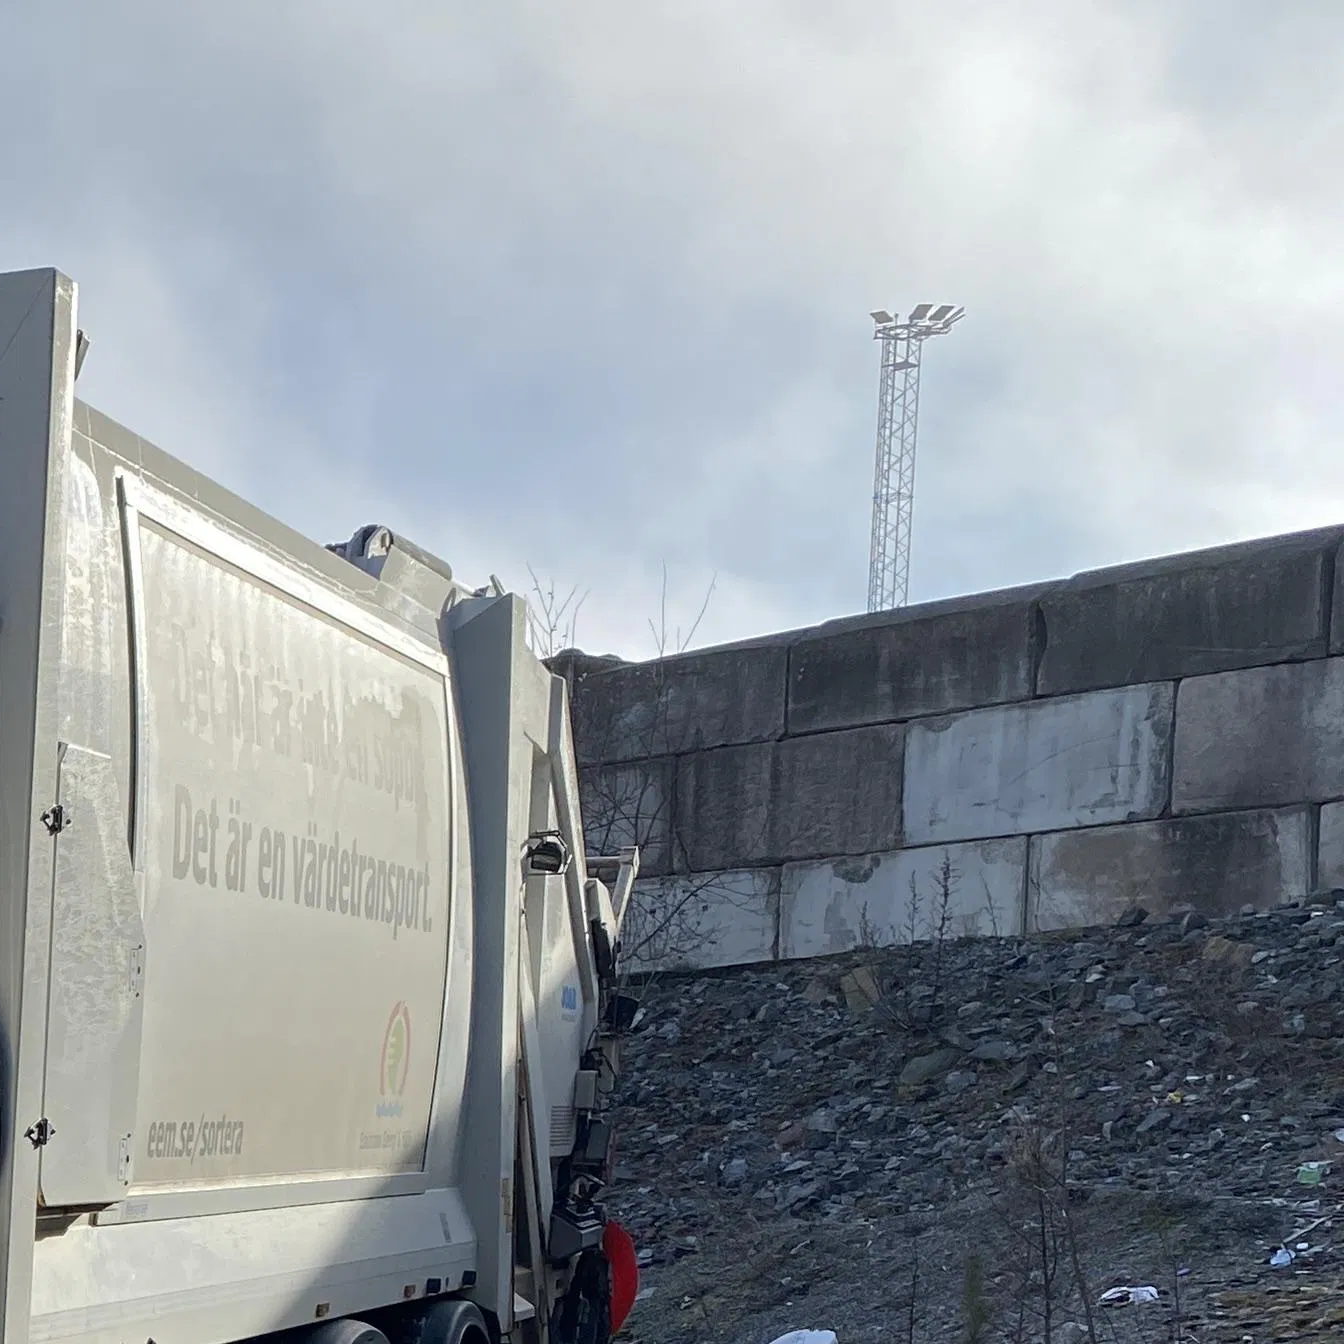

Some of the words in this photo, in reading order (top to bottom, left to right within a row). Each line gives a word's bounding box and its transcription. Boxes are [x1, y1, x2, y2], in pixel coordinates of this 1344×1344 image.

[172, 783, 219, 888] Det
[224, 797, 253, 893] är
[258, 826, 287, 901] en
[292, 820, 432, 941] värdetransport.
[146, 1112, 244, 1166] eem.se/sortera
